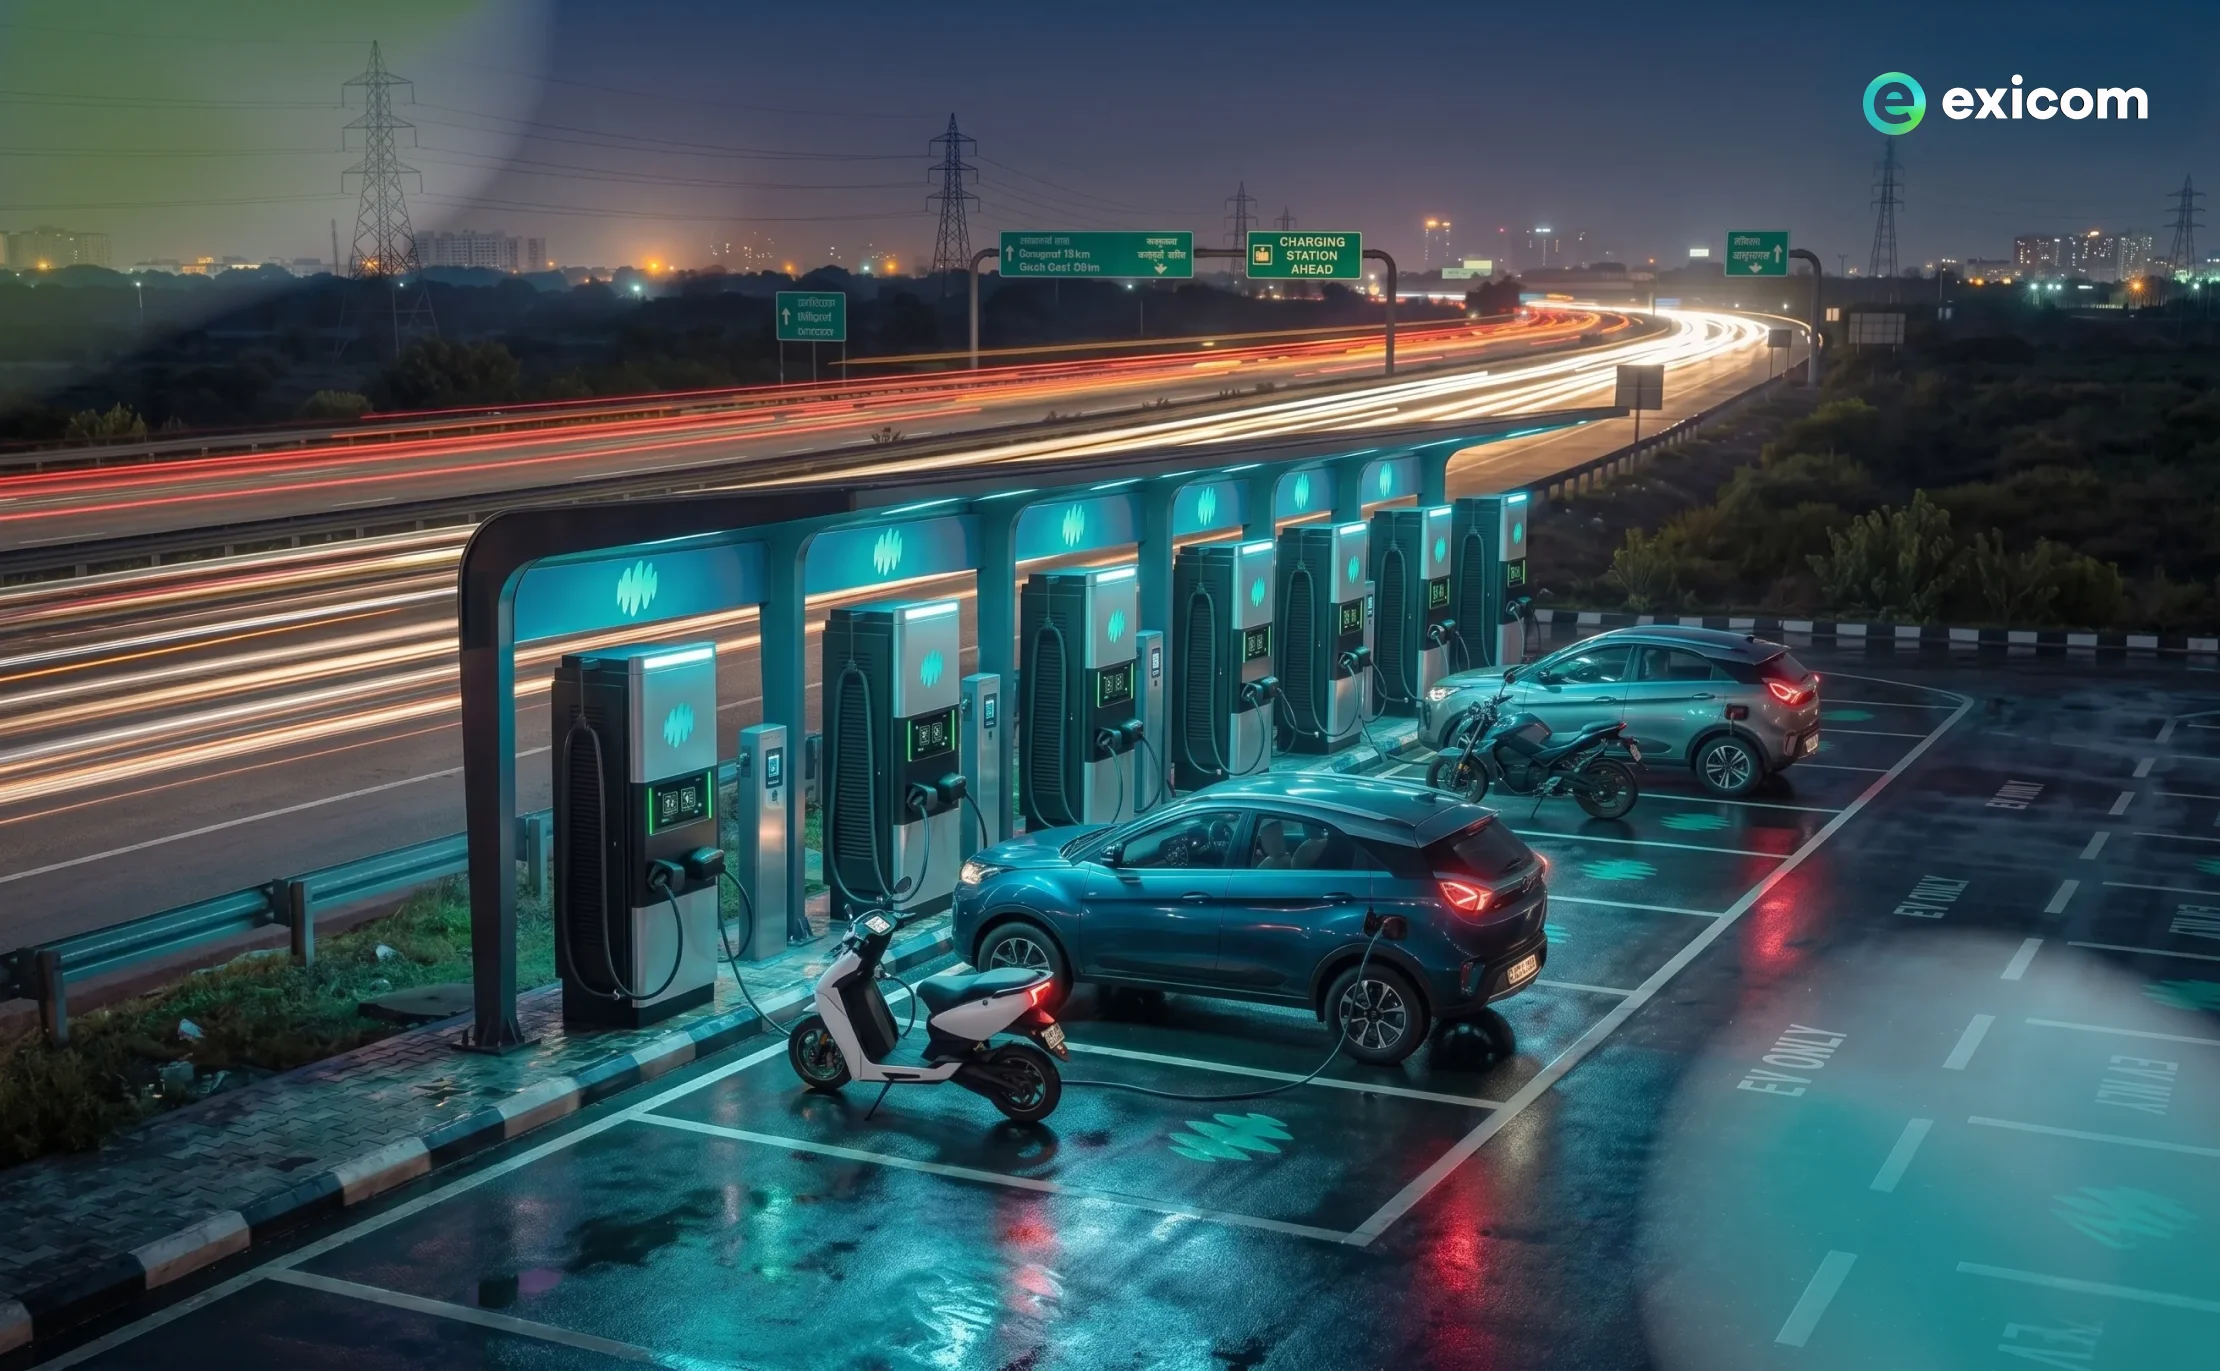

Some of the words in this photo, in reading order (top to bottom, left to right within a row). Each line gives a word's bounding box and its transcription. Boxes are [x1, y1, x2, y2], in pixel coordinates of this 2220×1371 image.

[1279, 236, 1346, 248] CHARGING
[1286, 250, 1338, 261] STATION
[1291, 264, 1334, 275] AHEAD
[1908, 874, 1970, 902] ONLY
[1893, 901, 1949, 919] EV
[1762, 1023, 1847, 1069] ONLY
[2107, 1055, 2179, 1082] EV
[1736, 1068, 1812, 1097] EV
